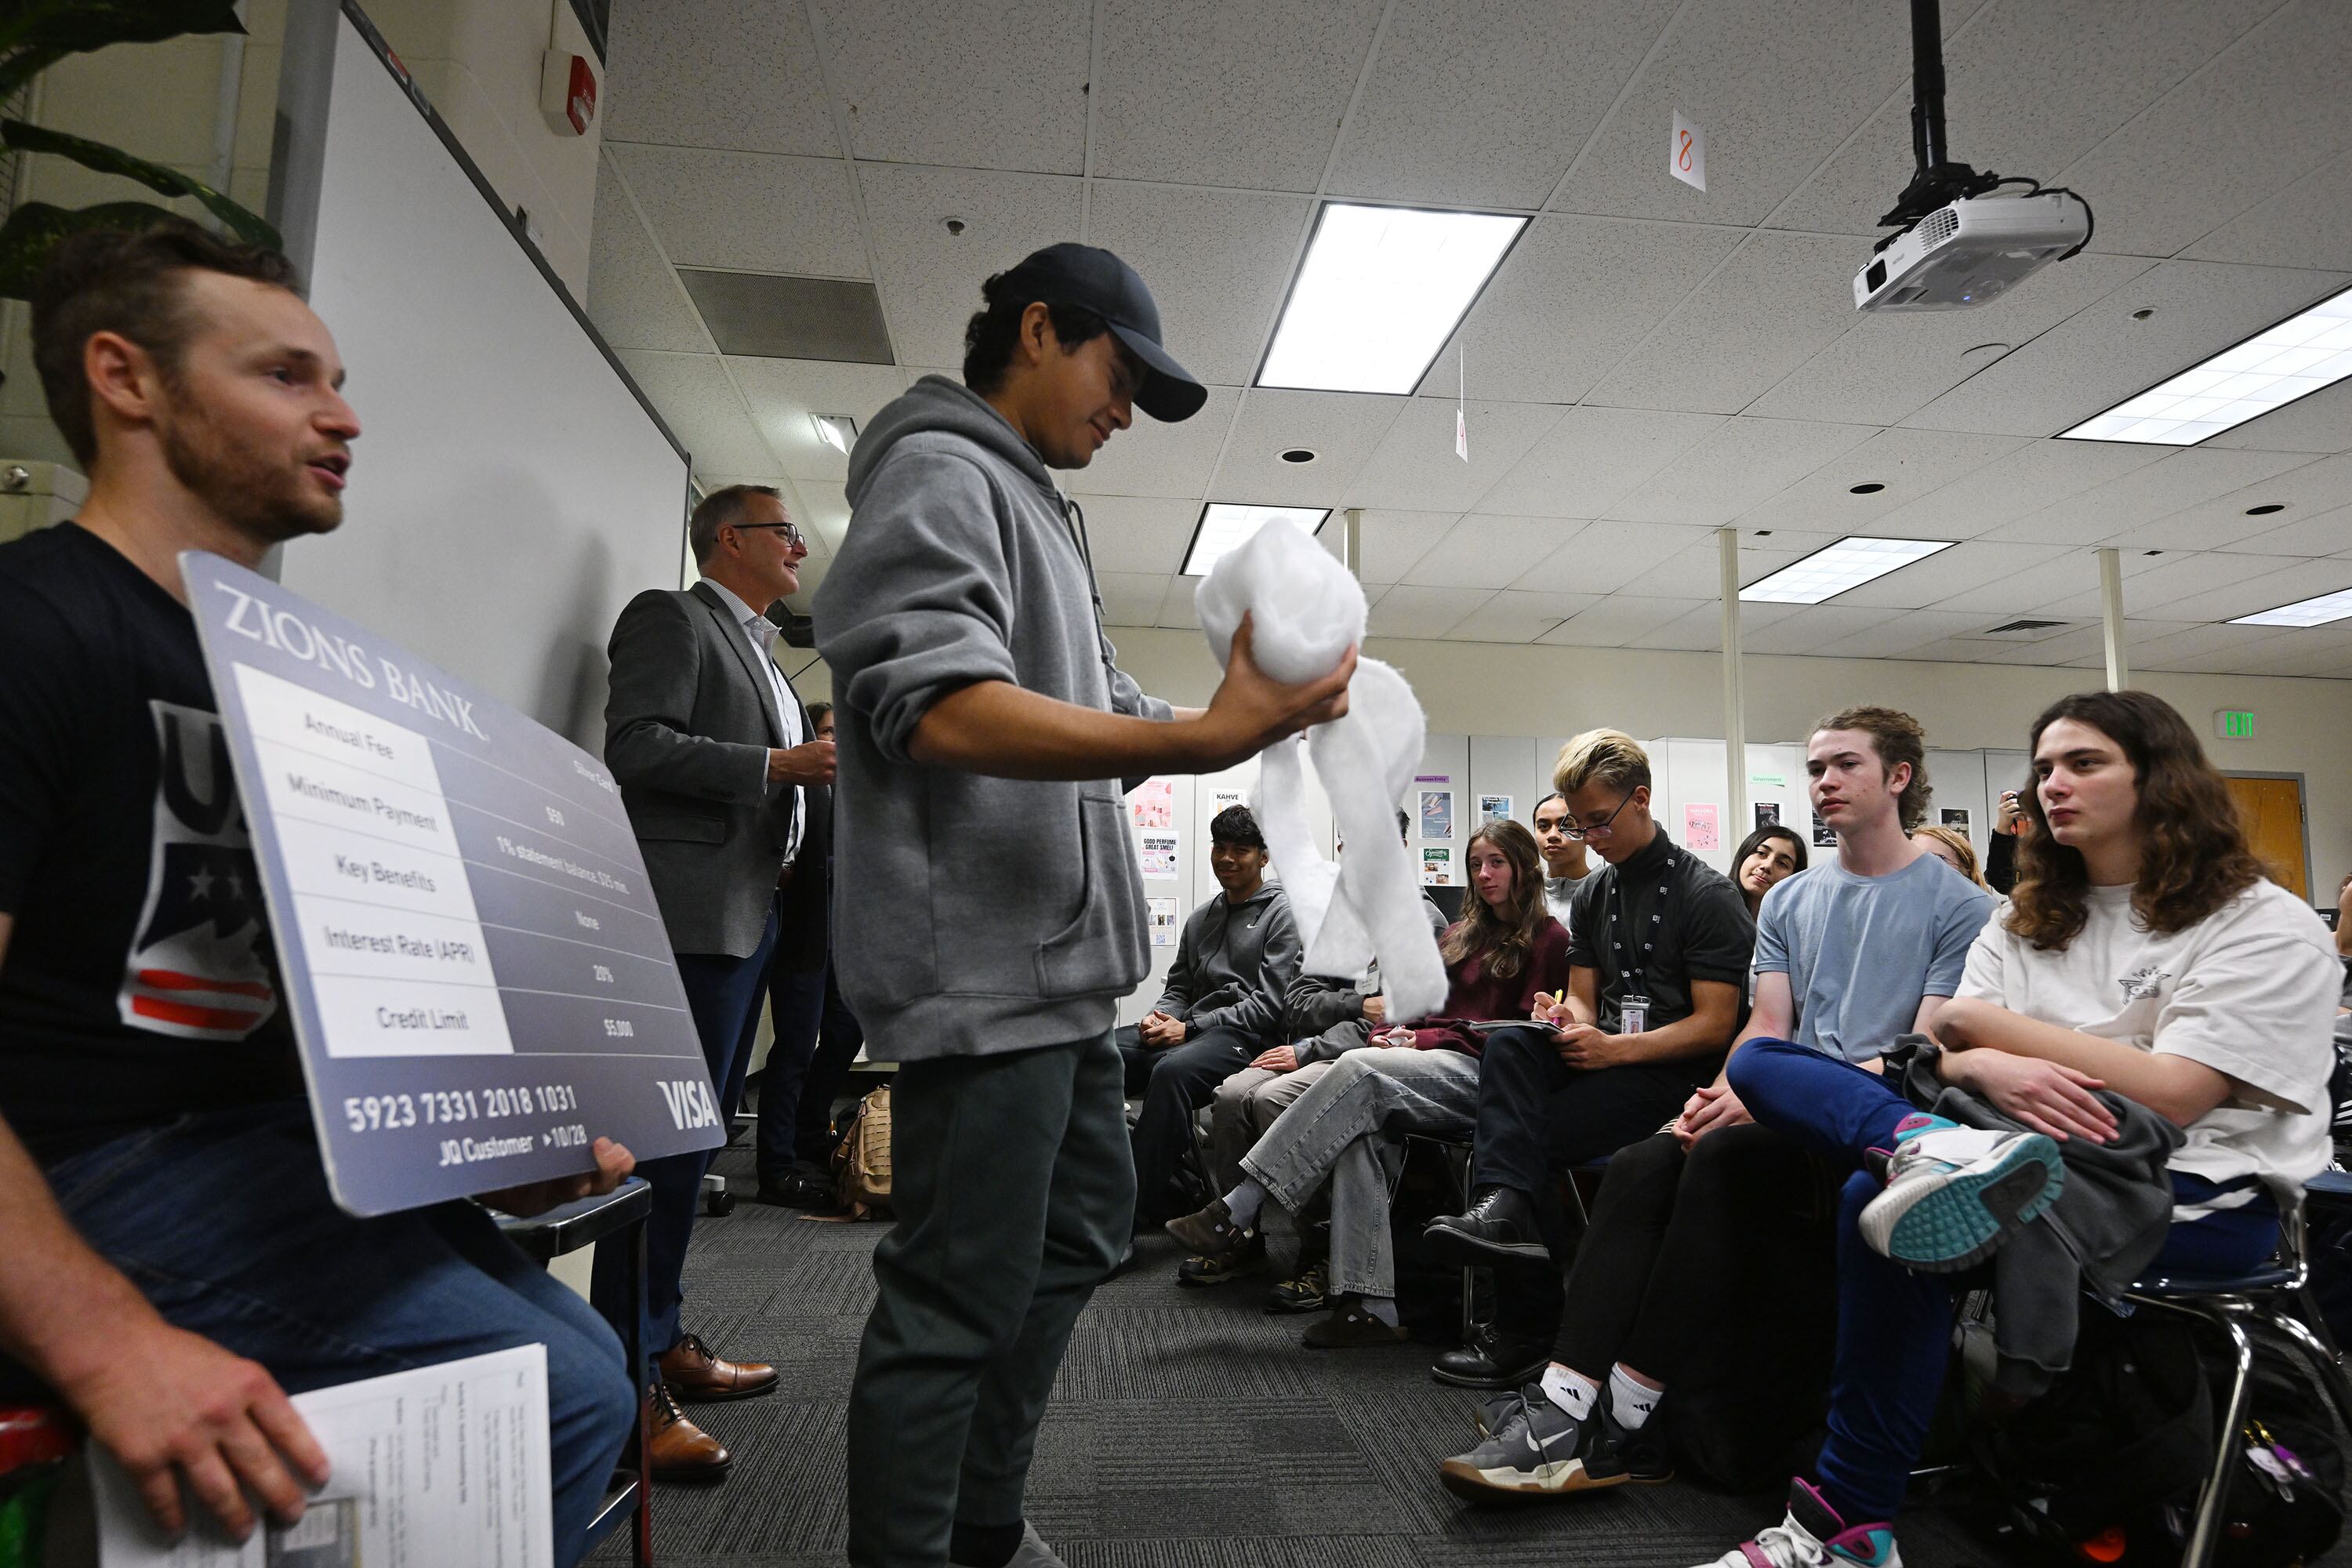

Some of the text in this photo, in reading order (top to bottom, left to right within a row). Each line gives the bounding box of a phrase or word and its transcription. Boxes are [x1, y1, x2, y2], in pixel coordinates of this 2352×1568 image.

[1679, 129, 1693, 172] 8
[213, 579, 491, 742] ZIONS BANK
[304, 711, 395, 760] Annual Fee
[2225, 712, 2255, 738] EXIT
[286, 771, 439, 833] Minimum Payment
[595, 773, 614, 793] Card
[545, 806, 565, 826] $50
[334, 853, 437, 893] Key Benefits
[496, 836, 516, 856] 1%
[515, 845, 566, 872] statement
[575, 910, 601, 931] None
[323, 925, 476, 965] Interest Rate (APR)
[593, 964, 615, 983] 20%
[377, 1007, 470, 1030] Credit Limit
[343, 1084, 577, 1133] 5923 7331 2018 1031
[655, 1080, 719, 1130] VISA
[438, 1123, 587, 1167] JQ Customer 10/28
